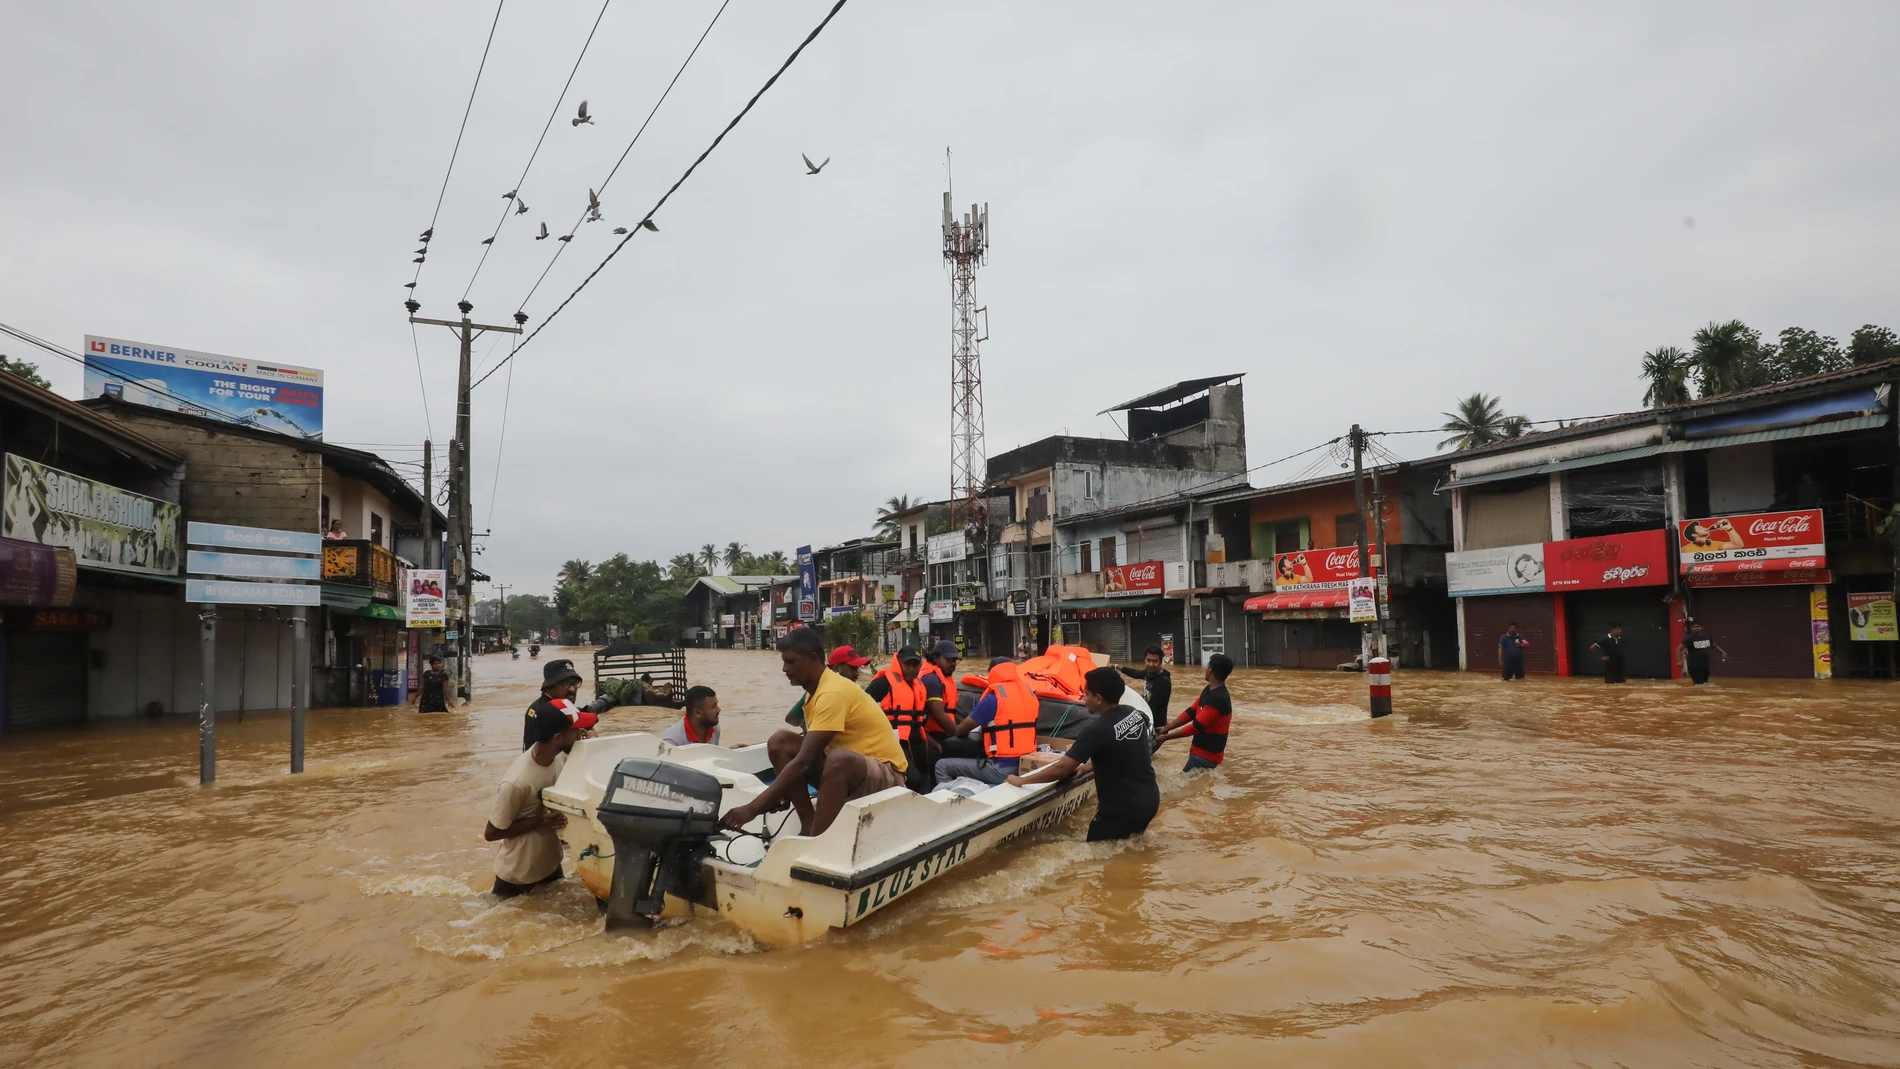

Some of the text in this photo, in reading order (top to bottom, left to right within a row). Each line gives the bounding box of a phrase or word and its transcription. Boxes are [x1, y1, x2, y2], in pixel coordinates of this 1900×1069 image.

[110, 344, 176, 363] BERNER
[185, 360, 247, 373] COOLANT
[287, 374, 319, 383] GERMANY
[213, 380, 236, 389] THE
[240, 383, 276, 394] RIGHT
[209, 388, 234, 397] FOR
[237, 390, 271, 402] YOUR
[46, 472, 90, 518] SARA
[92, 486, 154, 533] FASHION
[1749, 515, 1812, 536] Coca-Cola
[1130, 565, 1156, 581] Coca-Cola
[205, 584, 304, 599] BIYAGAMA ROAD
[1321, 581, 1337, 589] FRESH
[621, 776, 670, 798] YAMAHA
